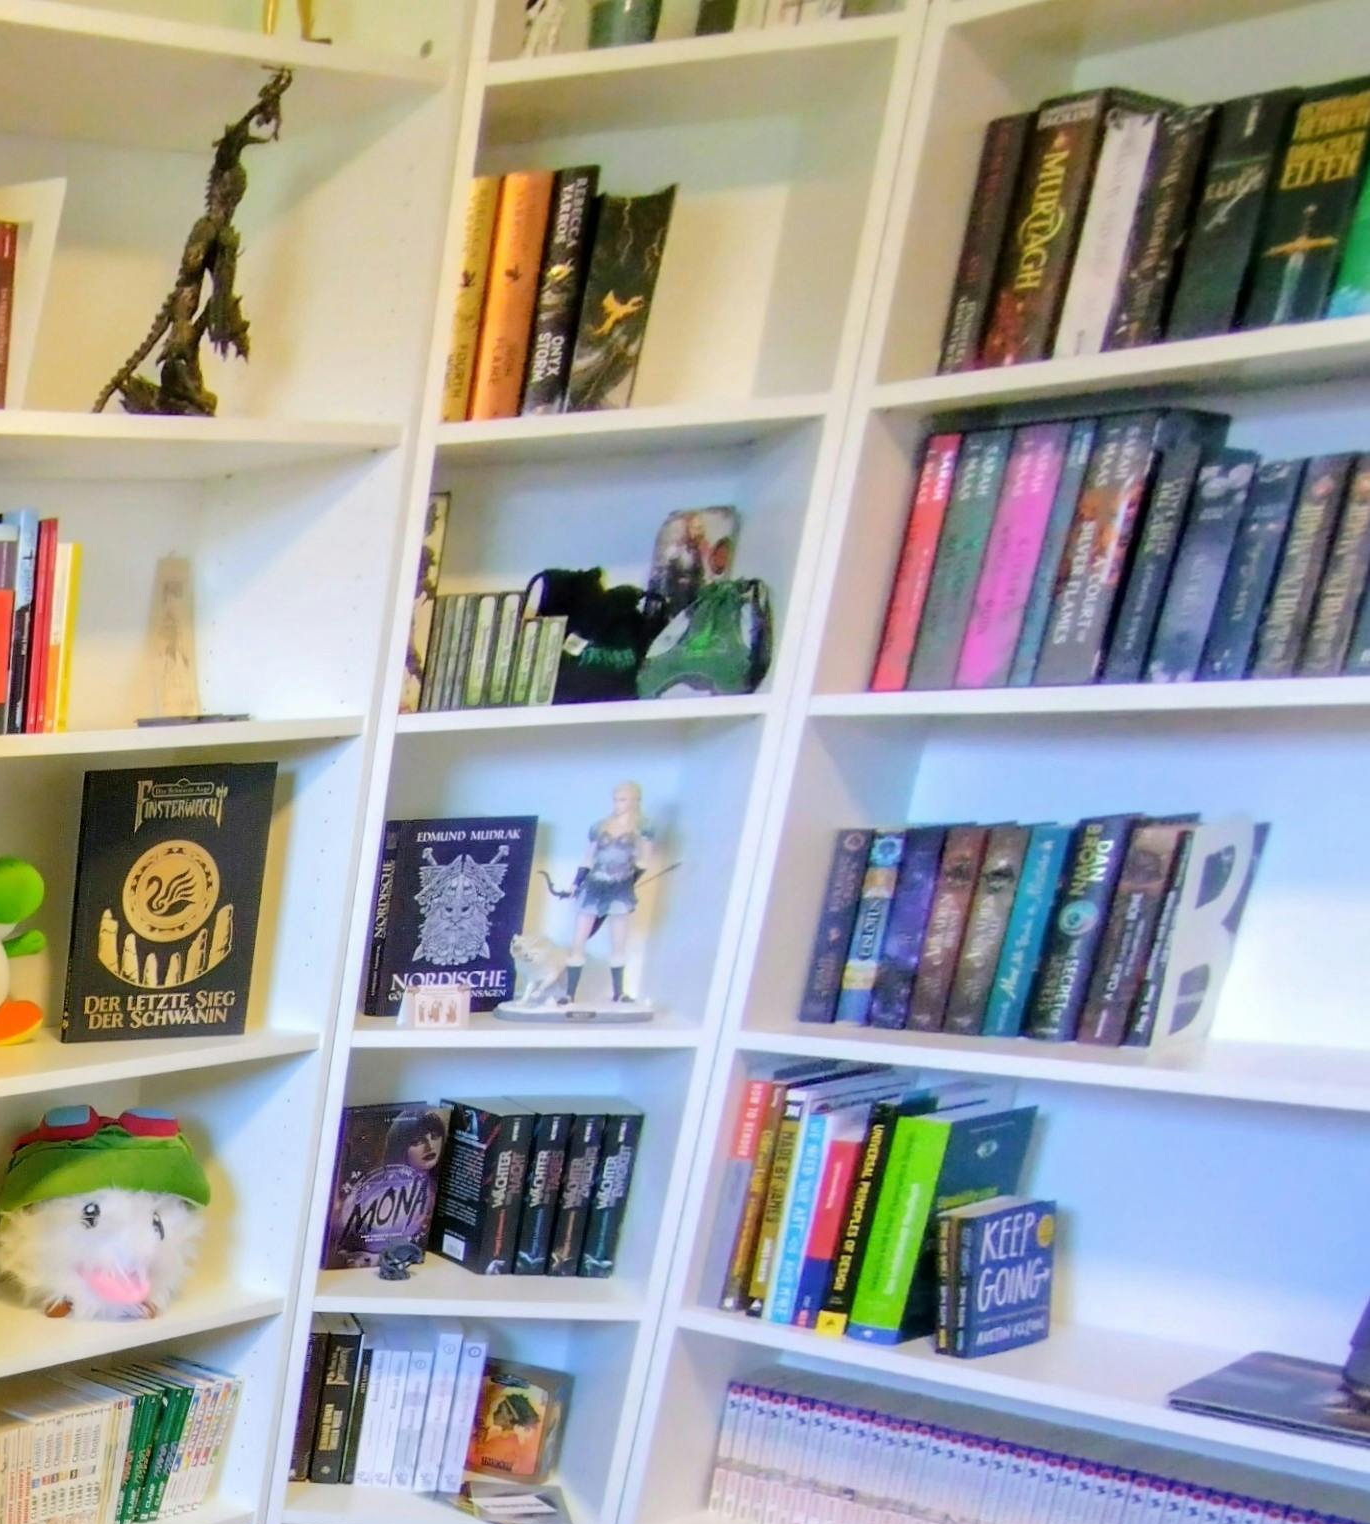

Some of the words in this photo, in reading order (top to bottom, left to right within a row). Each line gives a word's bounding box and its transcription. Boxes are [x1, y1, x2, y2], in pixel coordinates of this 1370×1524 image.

[555, 183, 575, 244] YARROS
[567, 177, 588, 248] REBECCA
[1014, 150, 1071, 291] MURTAGH
[531, 333, 551, 383] STORM
[546, 335, 564, 376] ONYX
[934, 451, 954, 500] SARAH
[977, 445, 999, 496] SARAH
[1096, 443, 1117, 486] MAAS
[1115, 426, 1140, 479] SARAH
[1071, 521, 1095, 576] SILVER
[1054, 581, 1081, 645] FLAMES
[1078, 575, 1106, 628] COURT
[417, 830, 466, 843] EDMUND
[470, 829, 521, 841] MUDRAK
[1069, 824, 1103, 896] BROWN
[1090, 840, 1114, 882] DAN
[374, 859, 395, 938] NORDISCHE
[84, 996, 120, 1015] DER
[127, 993, 190, 1012] LETZTE
[195, 991, 235, 1008] SIEG
[391, 970, 506, 991] NORDISCHE
[1056, 960, 1079, 1009] SECRET
[89, 1013, 124, 1029] DER
[130, 1007, 228, 1028] SCHWÄNIN
[779, 1132, 795, 1161] MADE
[803, 1139, 816, 1171] NEED
[862, 1124, 884, 1177] UNIVERSAL
[492, 1150, 513, 1208] WÄCHTER
[511, 1152, 525, 1193] NACHT
[530, 1150, 550, 1208] WÄCHTER
[596, 1156, 618, 1209] WÄCHTER
[773, 1165, 788, 1179] BY
[339, 1177, 427, 1247] MONA
[766, 1180, 786, 1223] JAMES
[792, 1204, 807, 1232] ART
[848, 1181, 871, 1237] PRINCIPLES
[843, 1238, 856, 1253] OF
[980, 1212, 1036, 1265] KEEP
[833, 1257, 853, 1291] DESIGN
[978, 1257, 1050, 1312] GOING
